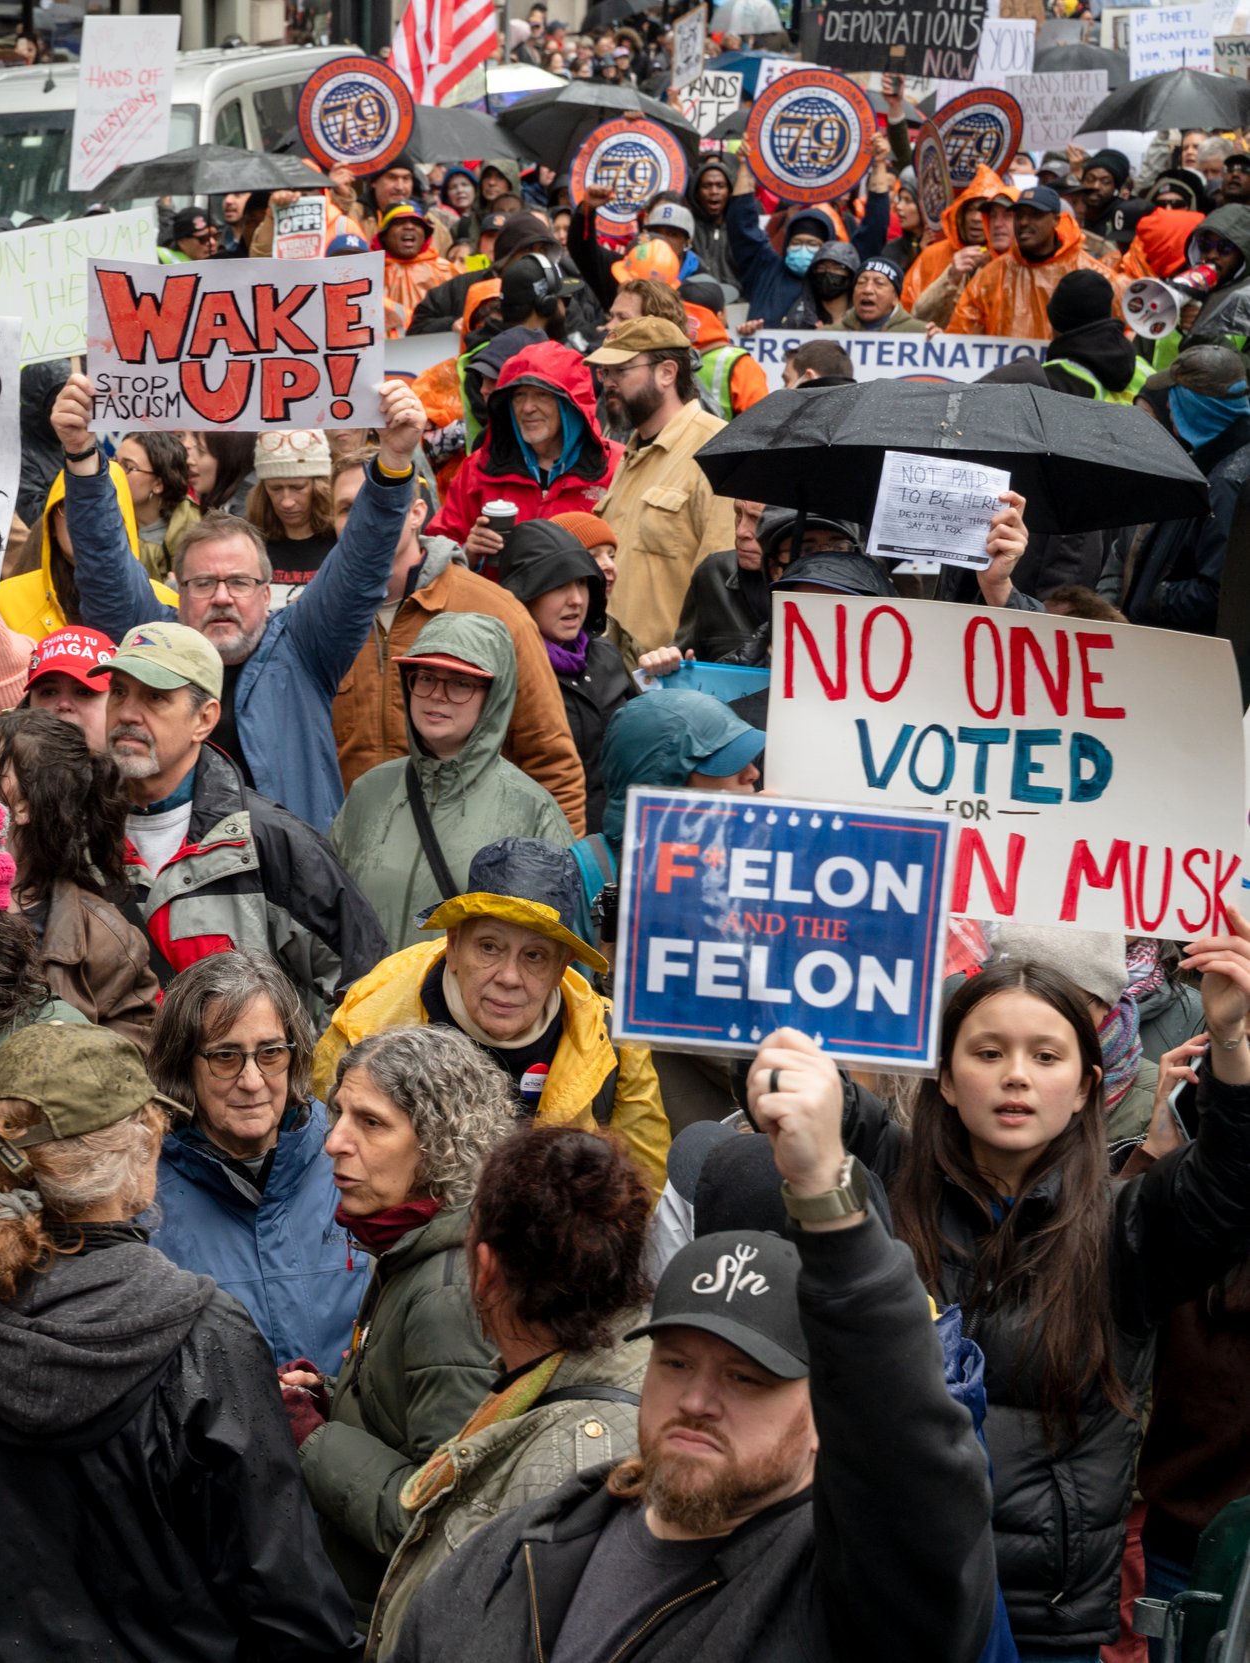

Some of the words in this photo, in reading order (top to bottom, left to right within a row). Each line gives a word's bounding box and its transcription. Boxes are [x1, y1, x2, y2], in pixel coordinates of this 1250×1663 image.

[824, 10, 983, 51] DEPORTATIONS
[1158, 10, 1193, 24] THEY
[85, 65, 132, 88] HANDS
[137, 68, 166, 86] OFF
[923, 48, 978, 80] NOW
[782, 73, 867, 113] INTERNATIONAL
[1006, 74, 1059, 96] TRANS
[80, 87, 158, 156] EVERYTHING
[320, 91, 390, 148] 79
[774, 110, 850, 166] 79
[948, 126, 1004, 172] 79
[597, 157, 662, 201] 79
[278, 204, 321, 219] HANDS
[278, 214, 321, 234] OFF!
[865, 261, 898, 280] FDNY
[22, 273, 88, 320] THE
[94, 265, 375, 366] WAKE
[838, 340, 1048, 368] NTERNATIO
[95, 373, 169, 395] STOP
[178, 353, 360, 424] UP!
[90, 391, 180, 420] FASCISM
[902, 465, 942, 485] NOT
[952, 468, 989, 489] PAID
[898, 487, 922, 504] TO
[928, 490, 959, 510] BE
[964, 491, 1002, 512] HERE
[906, 521, 922, 530] SAY
[944, 525, 964, 536] FOX
[941, 514, 962, 523] WHAT
[42, 632, 81, 649] CHINGA
[84, 636, 98, 646] TU
[42, 642, 95, 662] MAGA
[783, 600, 912, 702] NO
[963, 616, 1127, 720] ONE
[855, 717, 1114, 805] VOTED
[944, 799, 992, 822] FOR
[1058, 837, 1242, 938] MUSK
[721, 912, 786, 936] AND
[792, 915, 849, 942] THE
[646, 936, 914, 1017] FELON
